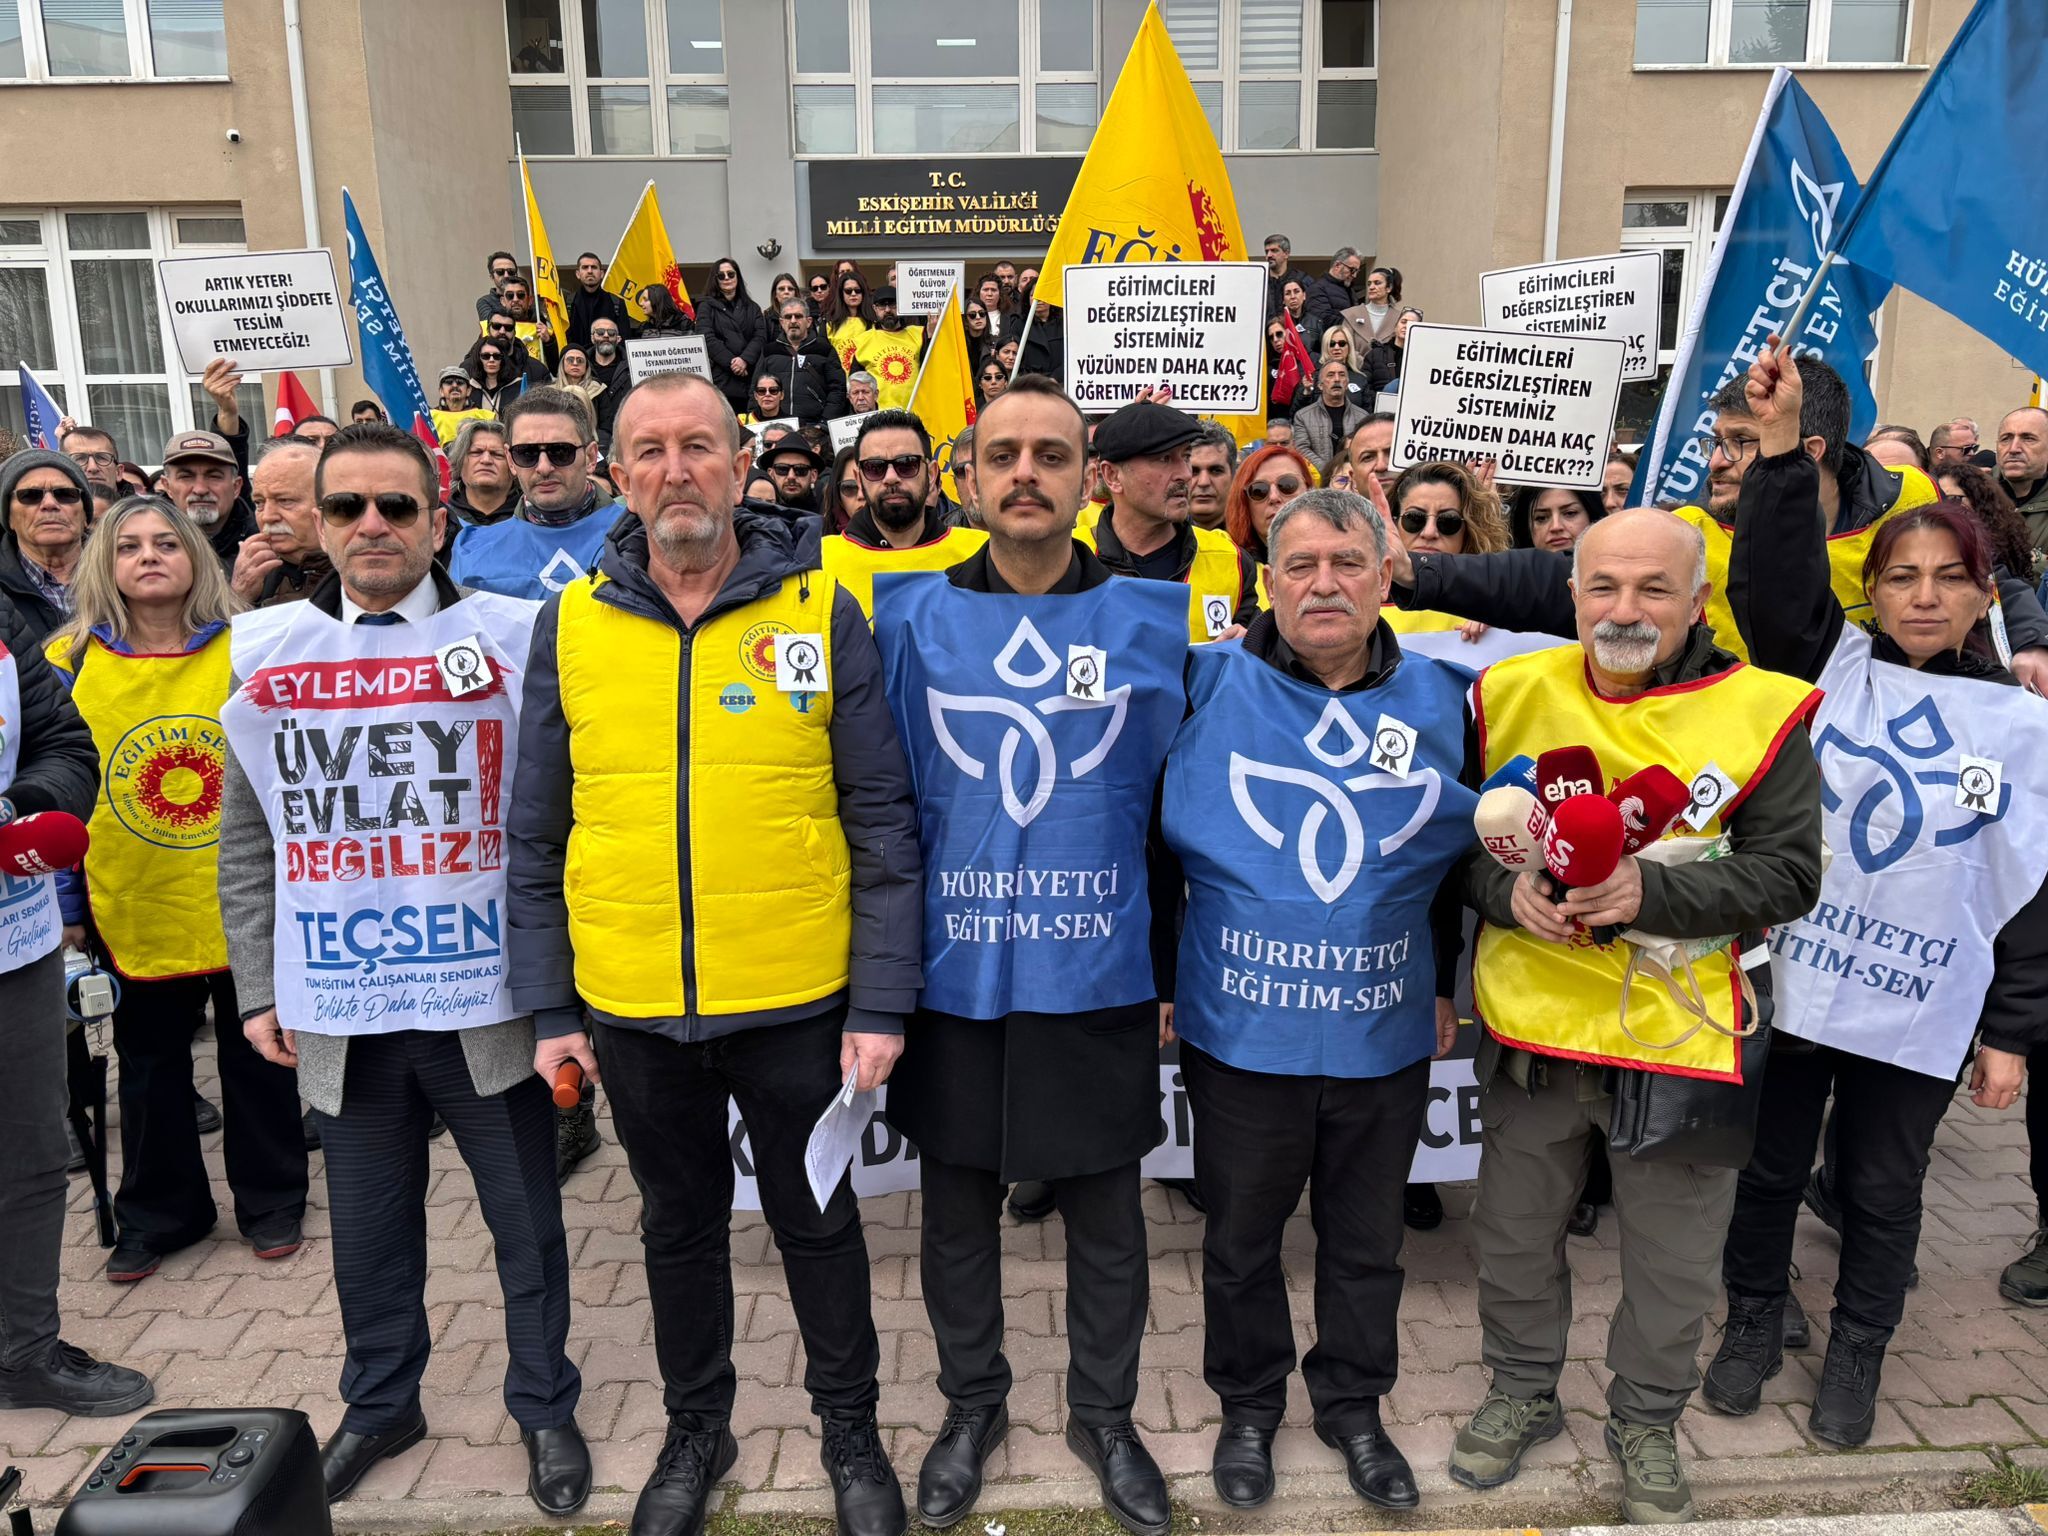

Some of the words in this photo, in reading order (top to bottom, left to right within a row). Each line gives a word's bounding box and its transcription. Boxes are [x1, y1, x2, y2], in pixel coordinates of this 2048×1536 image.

[858, 192, 955, 214] ESKİŞEHİR
[958, 191, 1038, 210] VALİLİĞİ
[884, 215, 952, 234] EĞİTİM
[955, 214, 1062, 234] MÜDÜRLÜĞ
[205, 276, 245, 292] ARTIK
[246, 274, 293, 289] YETER!
[909, 267, 955, 277] ÖĞRETMENLER
[920, 278, 946, 287] ÖLÜYOR
[1519, 266, 1615, 295] EĞİTİMCİLERİ
[912, 291, 933, 299] YUSUF
[935, 289, 950, 298] TEKİ
[1108, 274, 1216, 297] EĞİTİMCİLERİ
[175, 295, 274, 314] OKULLARIMIZI
[276, 292, 333, 311] ŞİDDETE
[1088, 301, 1236, 327] DEĞERSİZLEŞTİREN
[1502, 290, 1635, 320] DEĞERSİZLEŞTİREN
[234, 316, 283, 331] TESLİM
[1525, 313, 1607, 332] SİSTEMİNİZ
[214, 333, 310, 353] ETMEYECEĞİZ!
[1114, 328, 1205, 349] SİSTEMİNİZ
[632, 350, 652, 358] FATMA
[668, 347, 703, 355] ÖĞRETMEN
[646, 358, 691, 367] İSYANIMIZDIR!
[1457, 341, 1575, 369] EĞİTİMCİLERİ
[1078, 354, 1157, 375] YÜZÜNDEN
[1163, 358, 1209, 375] DAHA
[1214, 359, 1247, 379] KAÇ
[1430, 366, 1592, 399] DEĞERSİZLEŞTİREN
[1457, 394, 1556, 422] SİSTEMİNİZ
[1411, 416, 1503, 443] YÜZÜNDEN
[1507, 428, 1557, 448] DAHA
[1561, 433, 1596, 455] KAÇ
[1501, 449, 1594, 477] ÖLECEK???
[719, 695, 756, 706] KESK
[115, 726, 188, 779] EĞİTİM
[198, 730, 227, 752] SE
[274, 718, 474, 785] ÜVEY
[1544, 775, 1593, 802] eha
[282, 779, 471, 835] EVLAT
[152, 828, 178, 840] Bilim
[1484, 834, 1518, 850] GZT
[940, 862, 1118, 903] HÜRRİYETÇİ
[296, 899, 500, 975] TEÇ-SEN
[944, 908, 1113, 943] EĞİTİM-SEN
[1220, 926, 1410, 975] HÜRRİYETÇİ
[359, 971, 437, 993] ÇALIŞANLARI
[1221, 966, 1405, 1013] EĞİTİM-SEN
[364, 990, 417, 1022] Daha
[421, 982, 500, 1020] Güçlüyüz!
